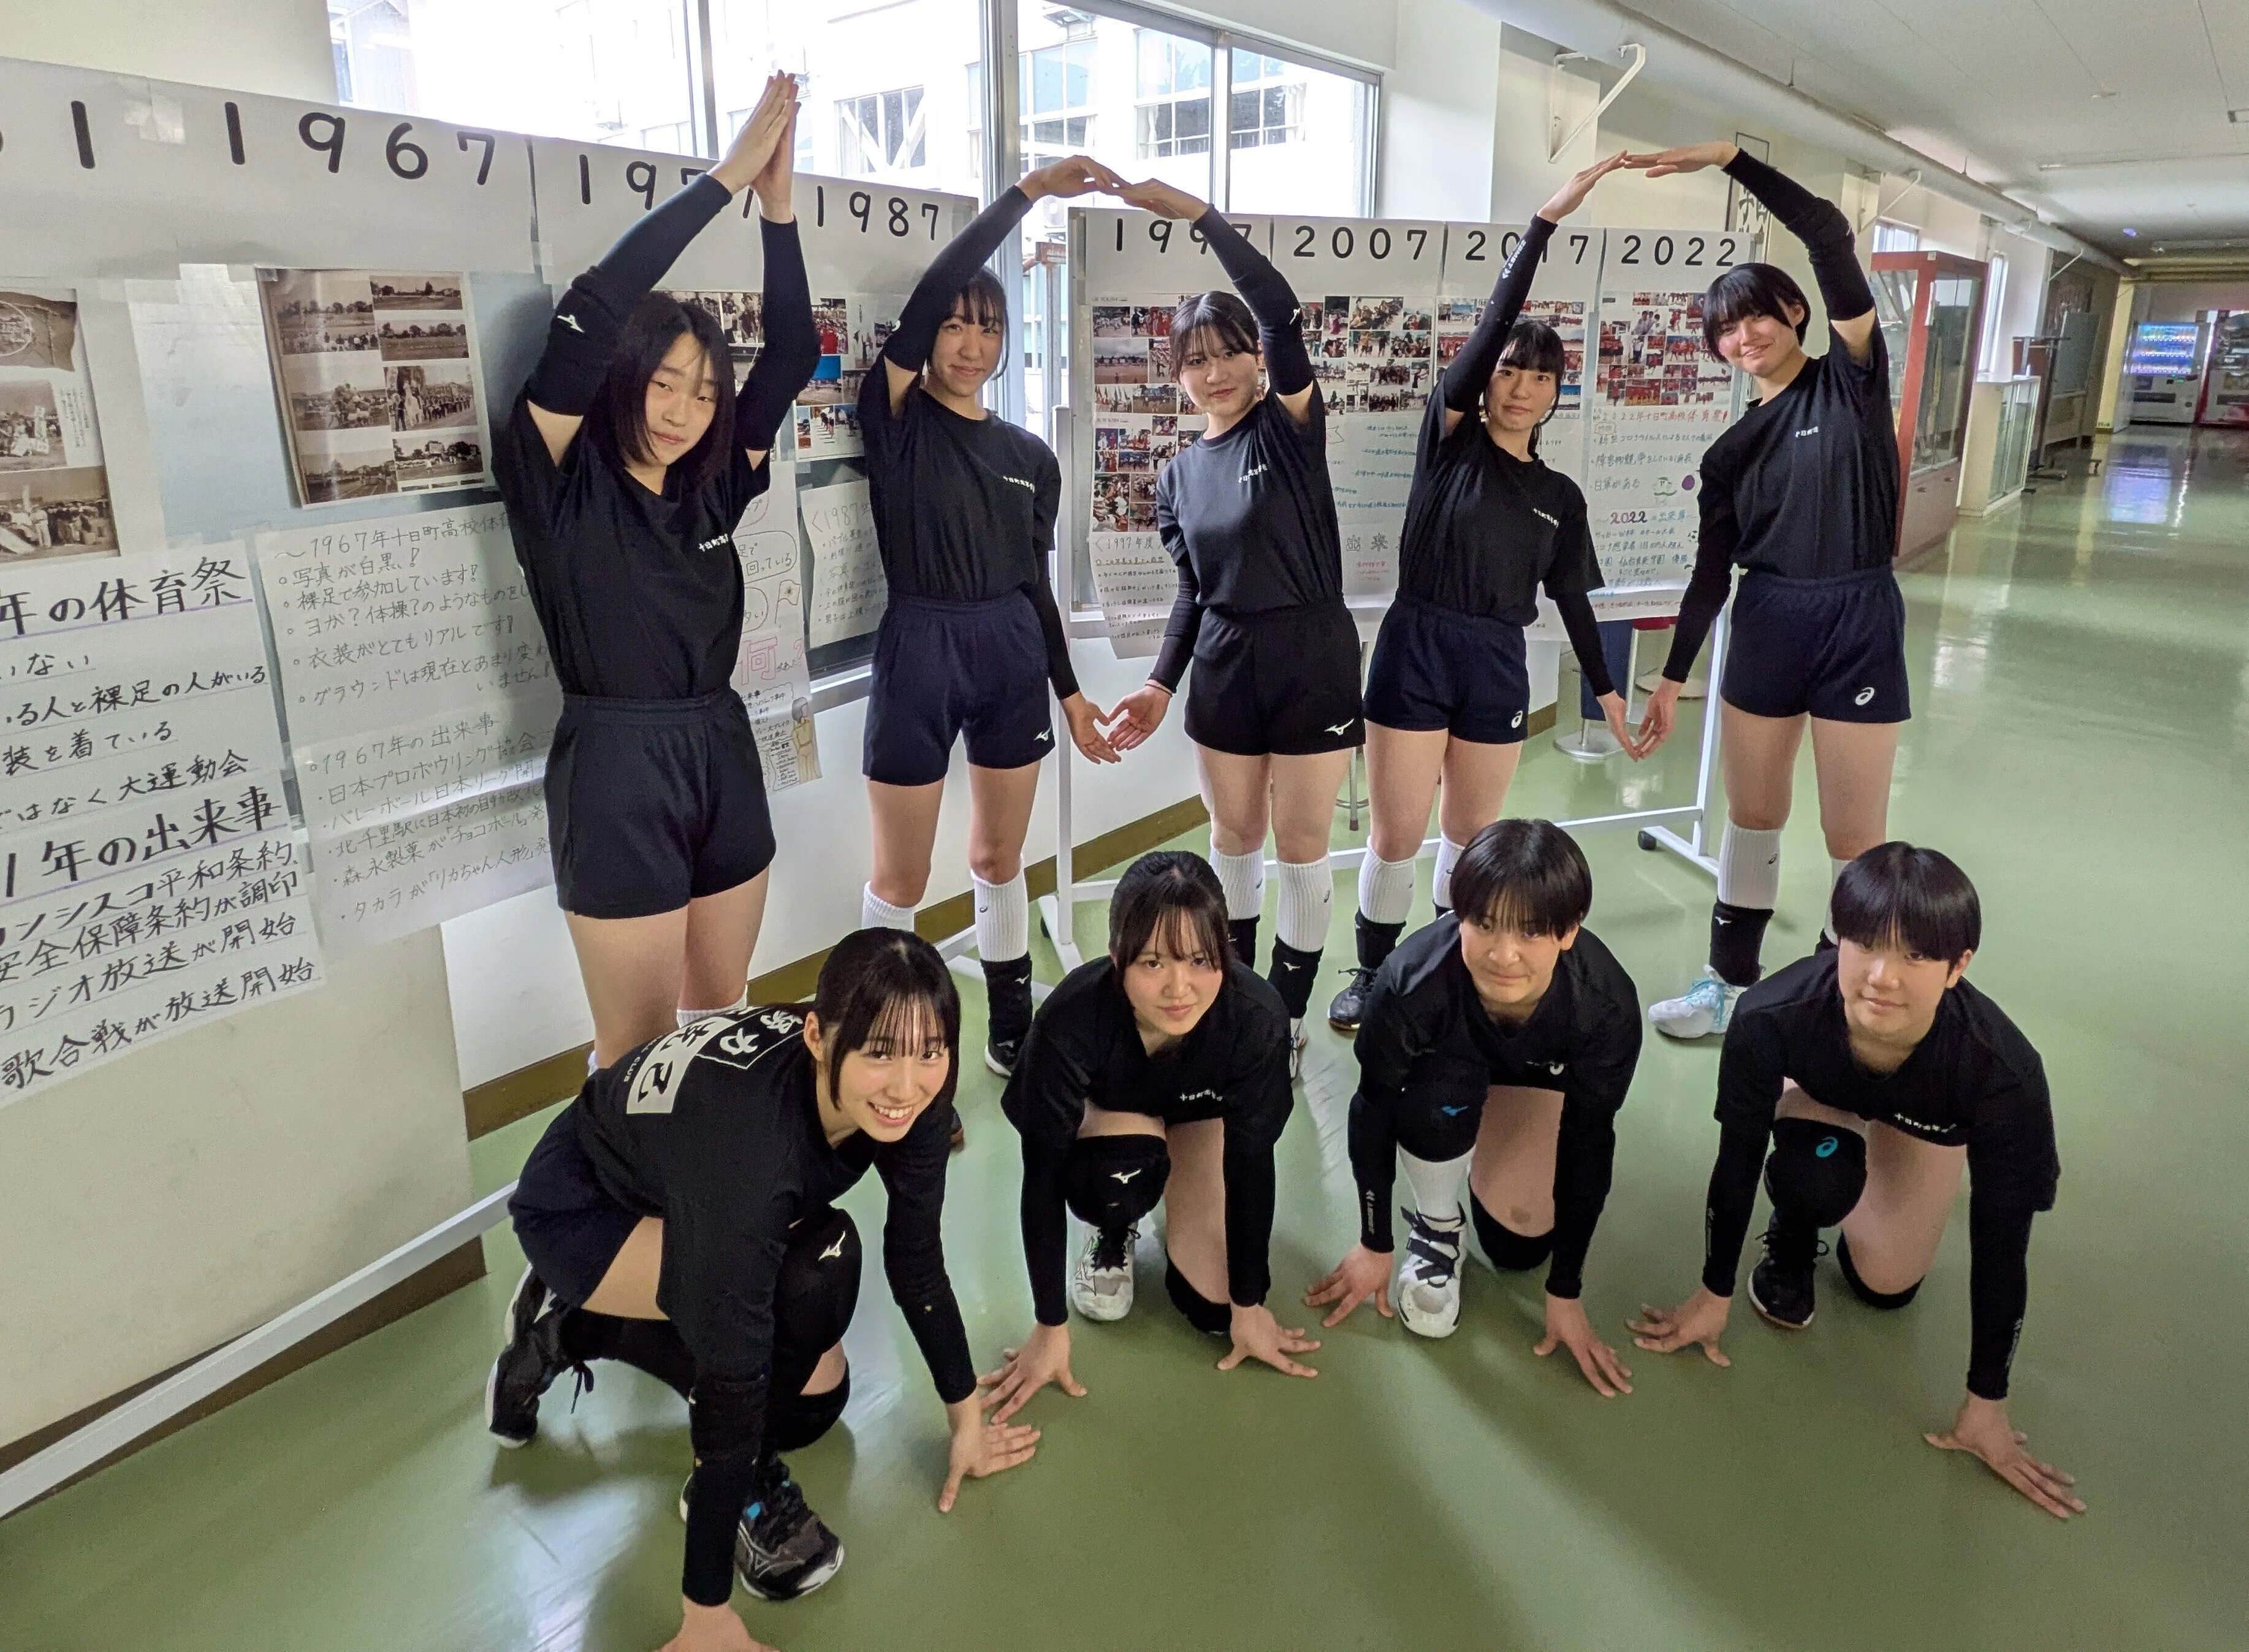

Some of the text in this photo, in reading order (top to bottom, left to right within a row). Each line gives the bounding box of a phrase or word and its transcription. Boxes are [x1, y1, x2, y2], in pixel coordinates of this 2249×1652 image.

[225, 101, 495, 186] 1967
[816, 186, 939, 241] 1987
[1293, 225, 1428, 261] 2007
[1621, 235, 1736, 266] 2022
[1610, 511, 1648, 525] 2022
[0, 749, 248, 821] はなく大運動会
